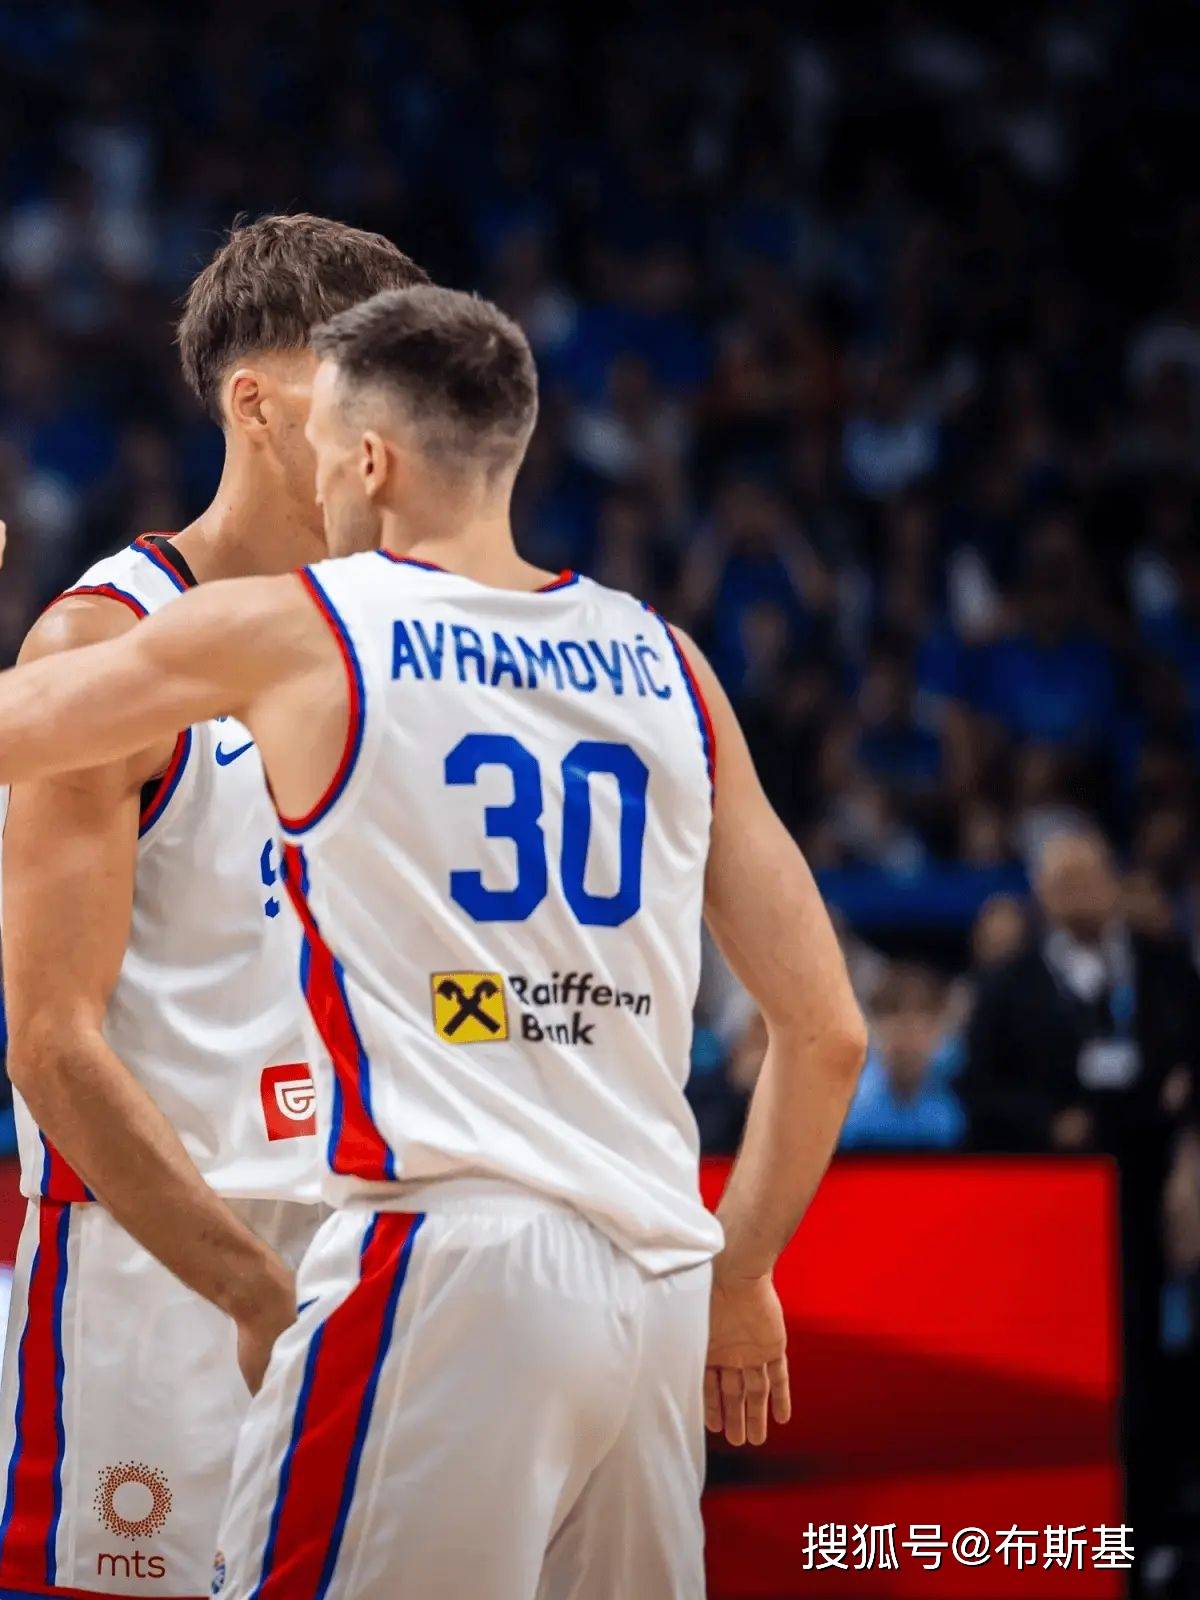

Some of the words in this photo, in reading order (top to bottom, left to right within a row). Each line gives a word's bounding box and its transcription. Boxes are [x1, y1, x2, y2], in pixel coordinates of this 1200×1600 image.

[390, 618, 672, 701] AVRAMOVIĆ
[443, 732, 650, 928] 30
[97, 1550, 166, 1579] mts
